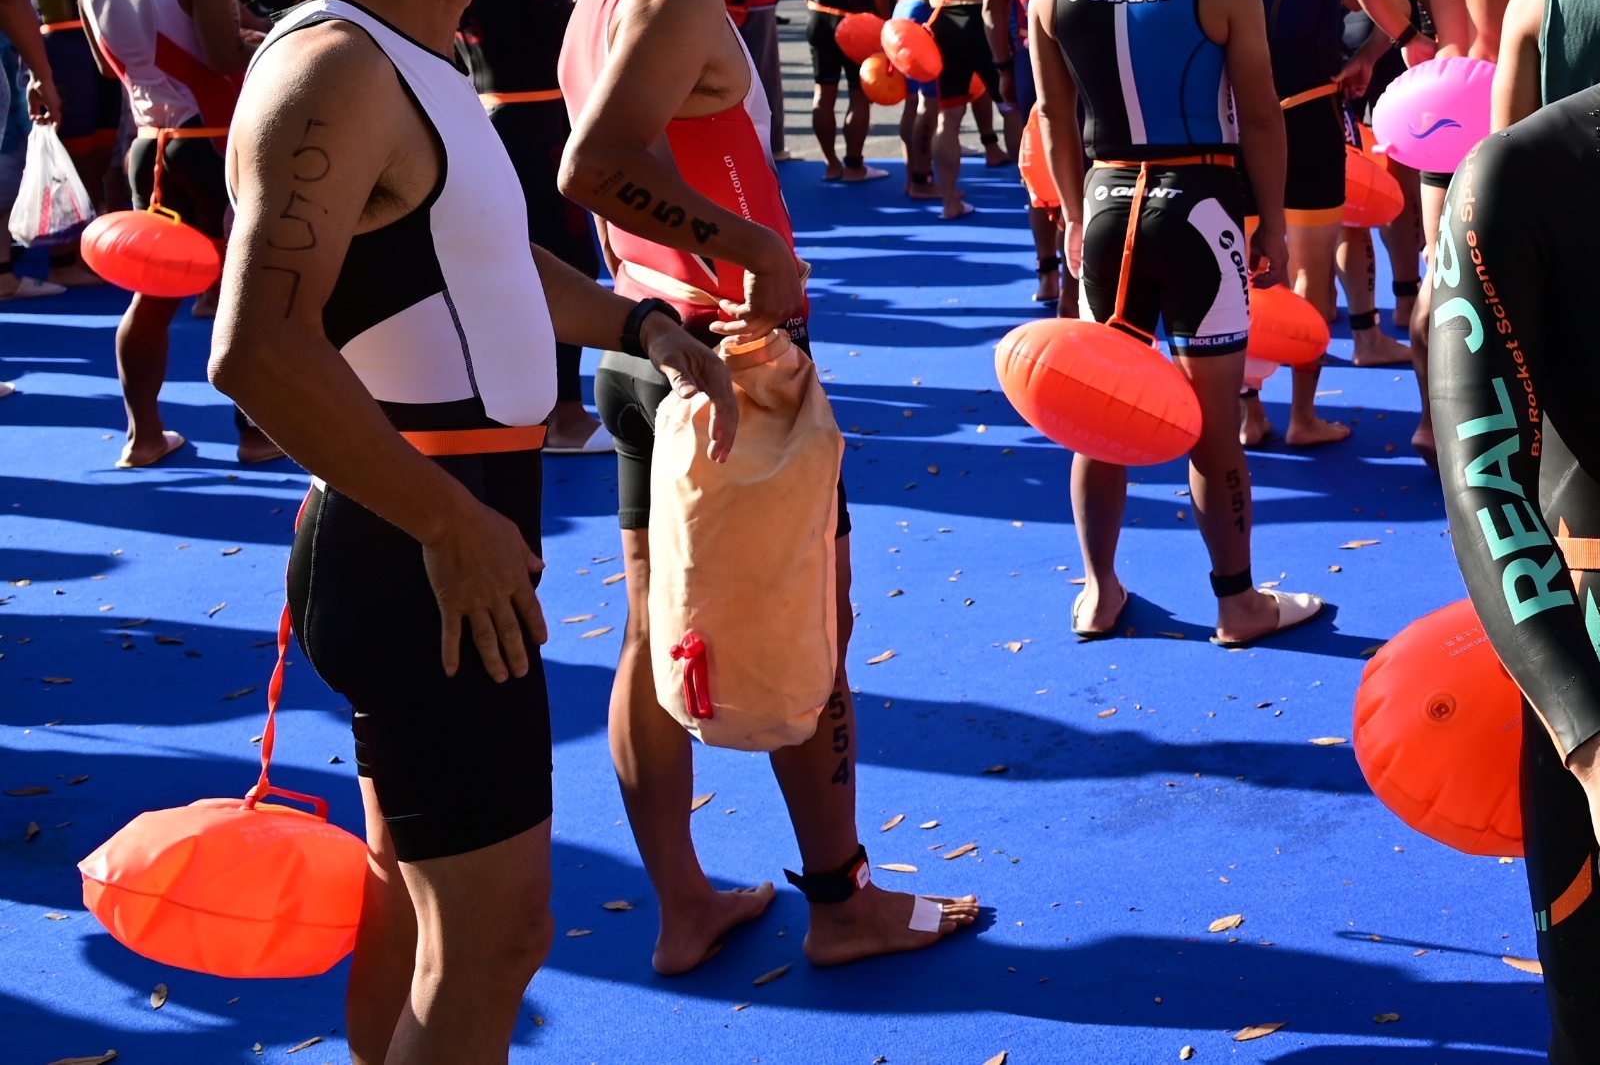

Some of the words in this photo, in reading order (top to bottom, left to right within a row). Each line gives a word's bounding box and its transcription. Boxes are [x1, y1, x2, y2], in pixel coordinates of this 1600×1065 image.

[615, 182, 720, 245] 554
[1110, 186, 1183, 199] GINT
[1230, 250, 1250, 316] GIAN
[1466, 230, 1512, 334] Science
[1189, 337, 1211, 346] RIDE
[1213, 335, 1233, 345] LIFE.
[1505, 339, 1540, 424] Rocket
[1531, 431, 1542, 458] By
[1226, 468, 1245, 534] 551
[1458, 377, 1575, 625] REAL
[828, 691, 850, 785] 554
